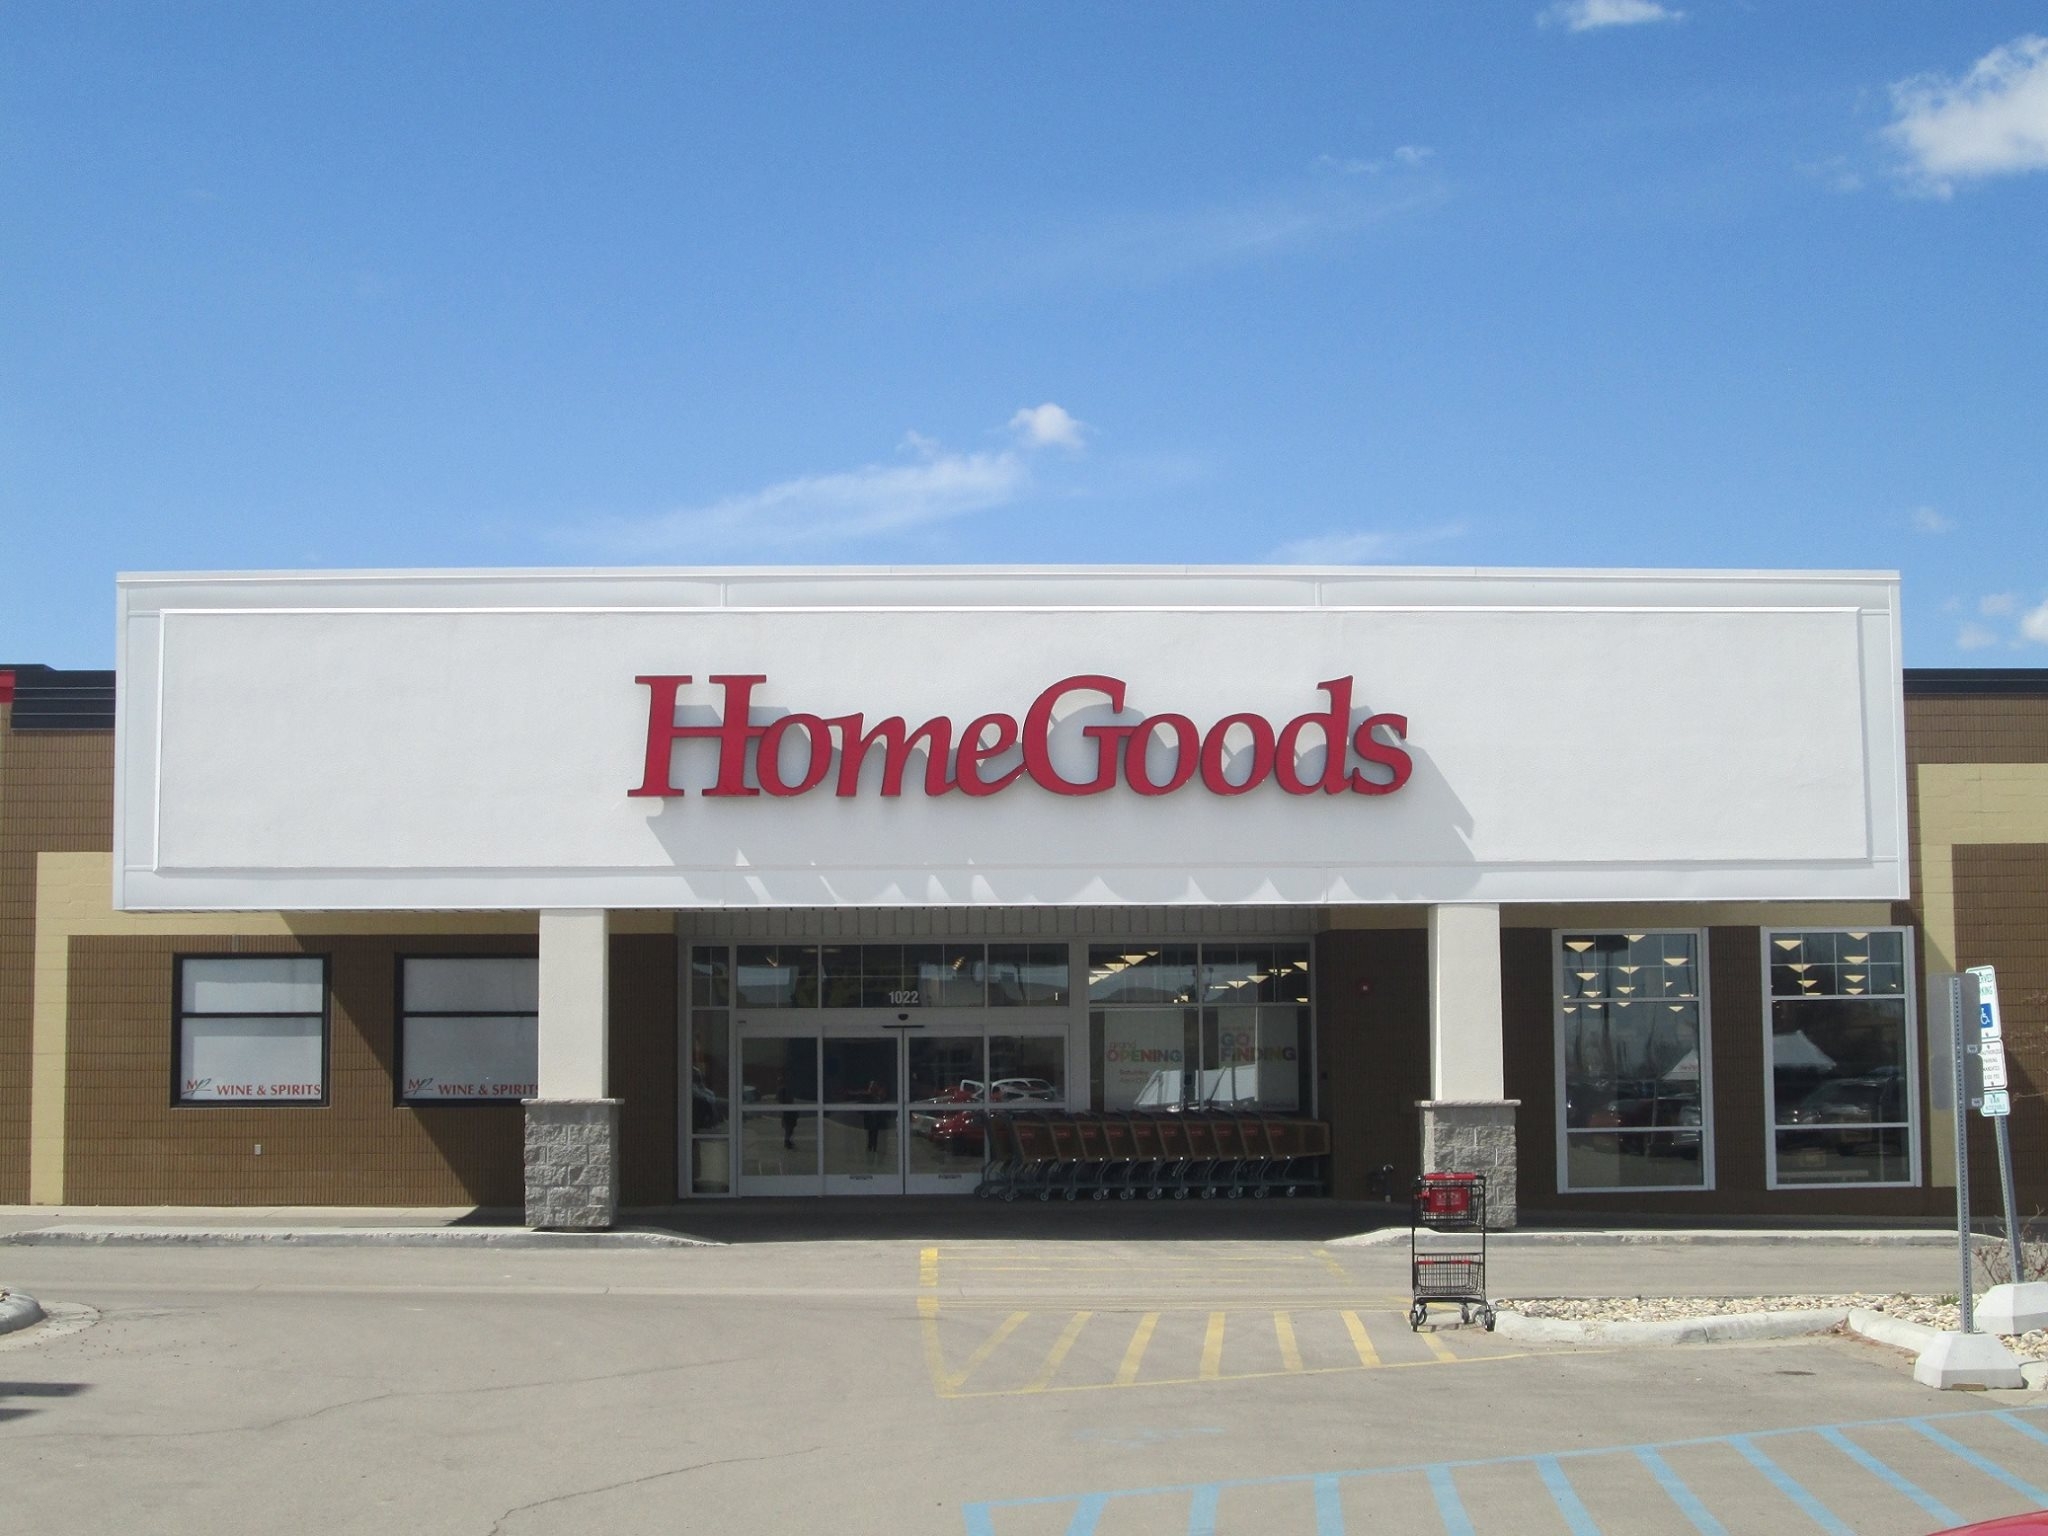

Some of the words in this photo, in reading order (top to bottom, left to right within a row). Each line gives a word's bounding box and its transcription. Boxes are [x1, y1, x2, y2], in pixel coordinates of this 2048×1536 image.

[627, 674, 1413, 798] HomeGoods
[888, 990, 919, 1004] 1022
[1221, 1032, 1249, 1047] GO
[1107, 1049, 1183, 1062] OPENING
[216, 1084, 253, 1096] WINE
[256, 1085, 267, 1096] &
[270, 1084, 322, 1096] SPIRITS
[437, 1083, 475, 1096] WINE
[477, 1084, 489, 1096] &
